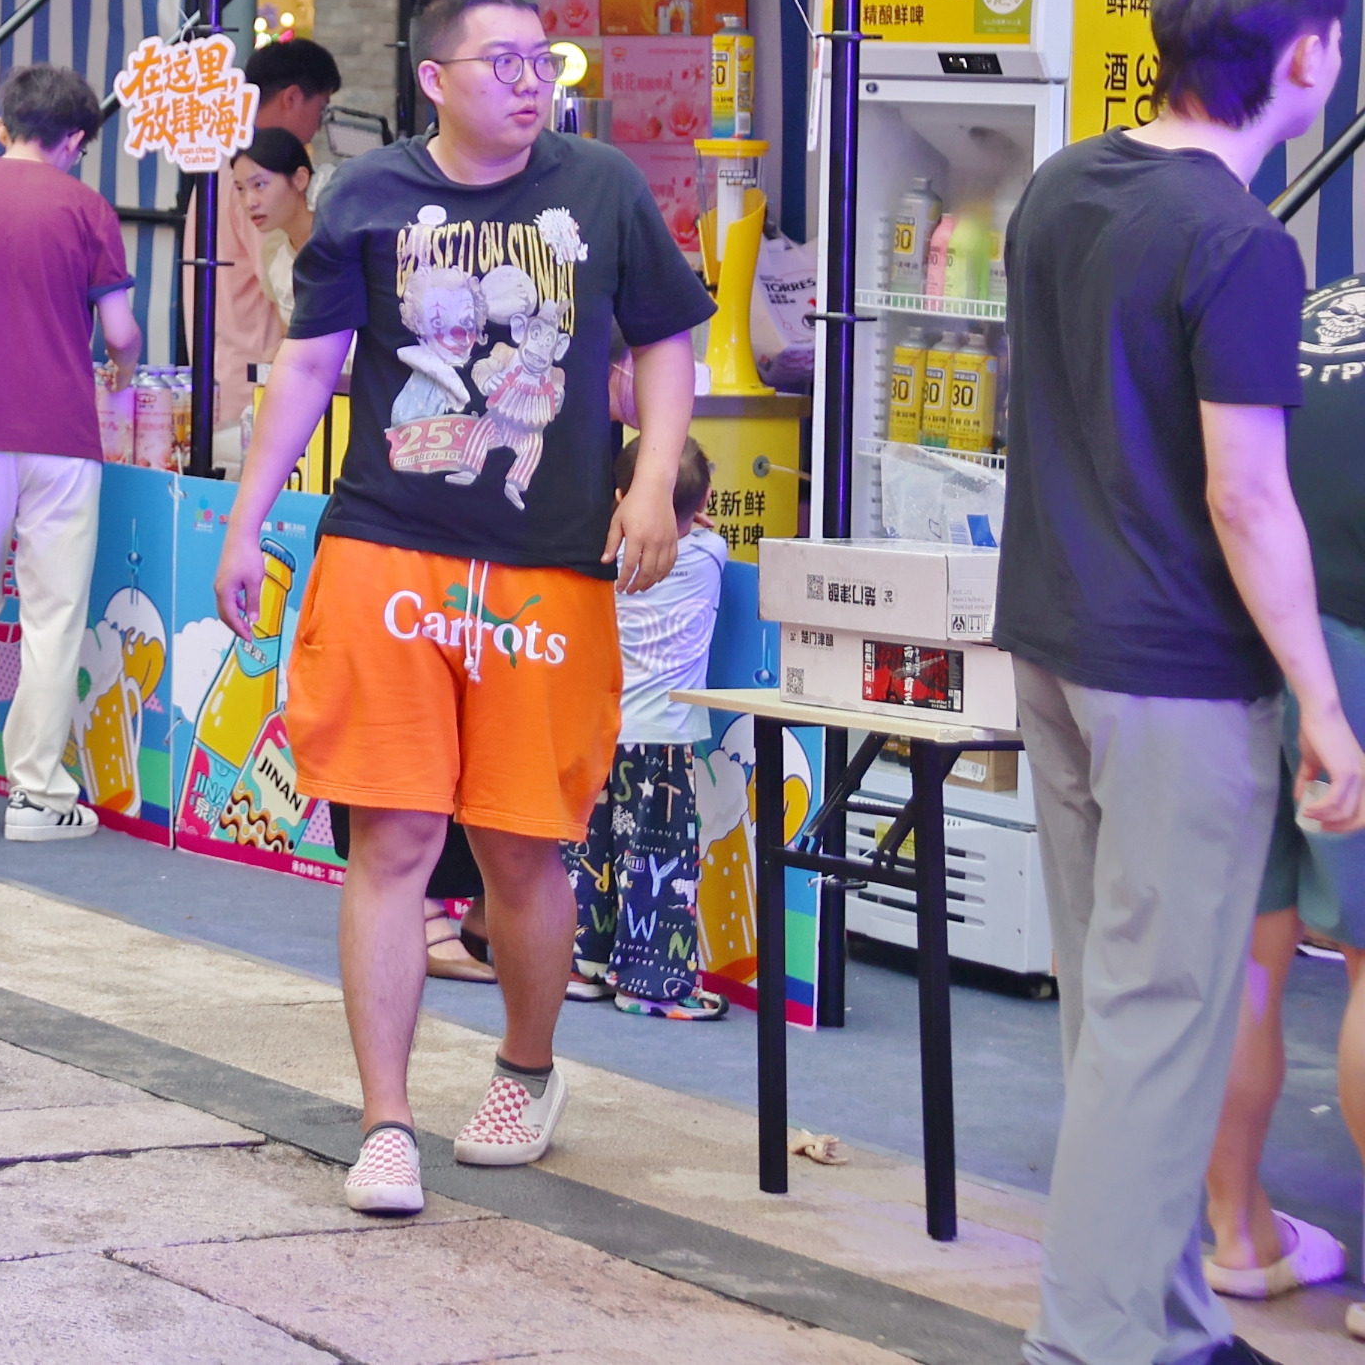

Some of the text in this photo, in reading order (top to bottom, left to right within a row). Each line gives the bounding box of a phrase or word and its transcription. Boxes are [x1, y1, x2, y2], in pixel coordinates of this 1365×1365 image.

[863, 5, 925, 26] 精酿鲜啤
[478, 221, 504, 273] ON
[952, 383, 973, 407] 30
[384, 589, 567, 666] Carrots
[194, 770, 228, 803] JINA
[258, 755, 303, 812] JINAN
